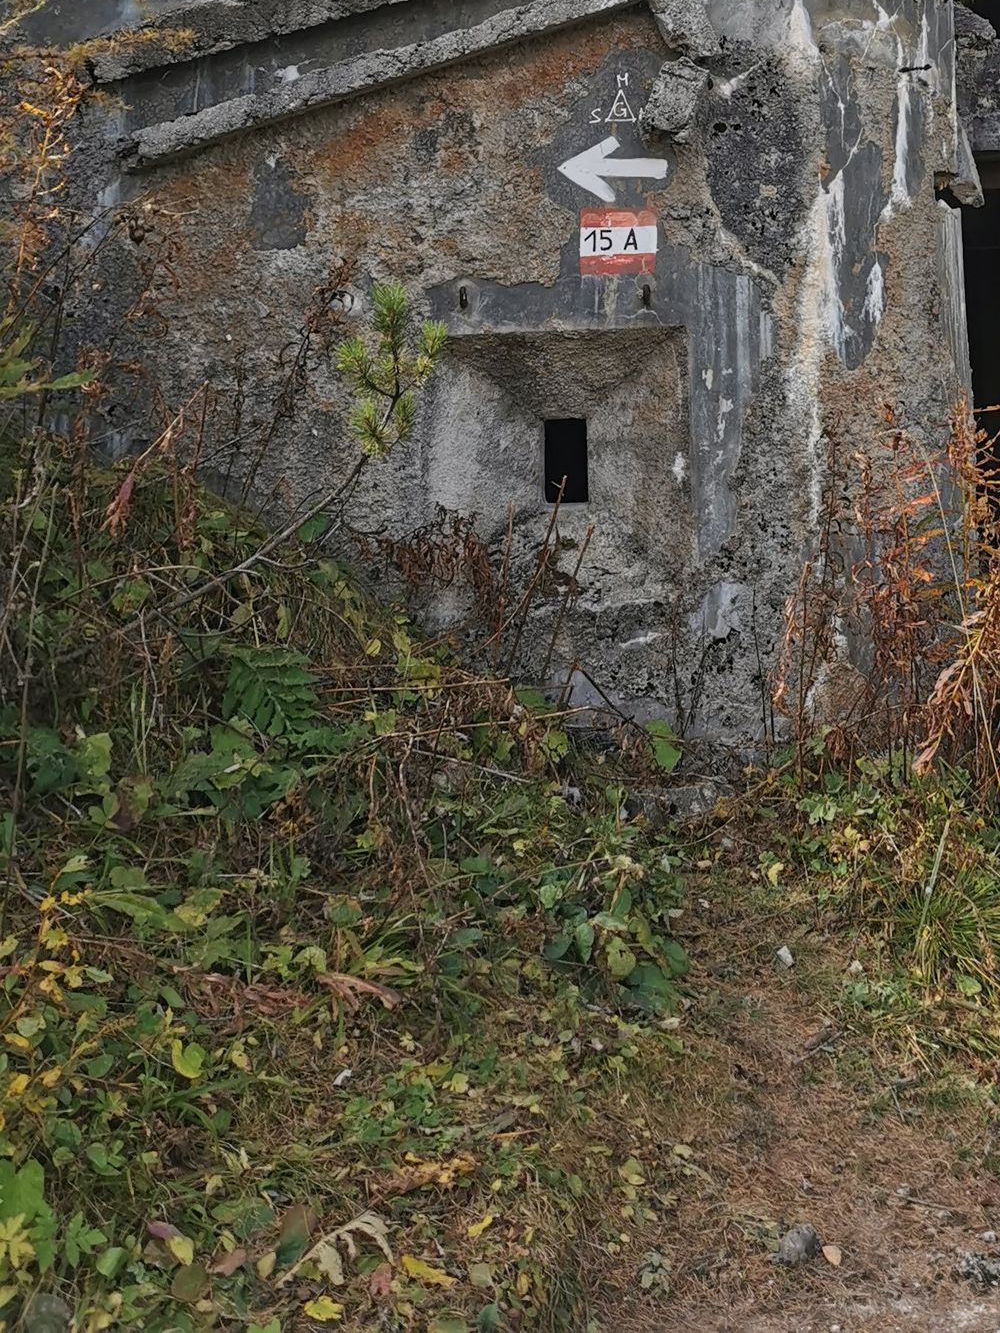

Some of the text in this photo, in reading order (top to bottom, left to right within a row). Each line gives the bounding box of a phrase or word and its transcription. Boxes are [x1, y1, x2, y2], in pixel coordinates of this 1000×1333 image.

[613, 102, 627, 117] G
[584, 228, 638, 252] 15 A
